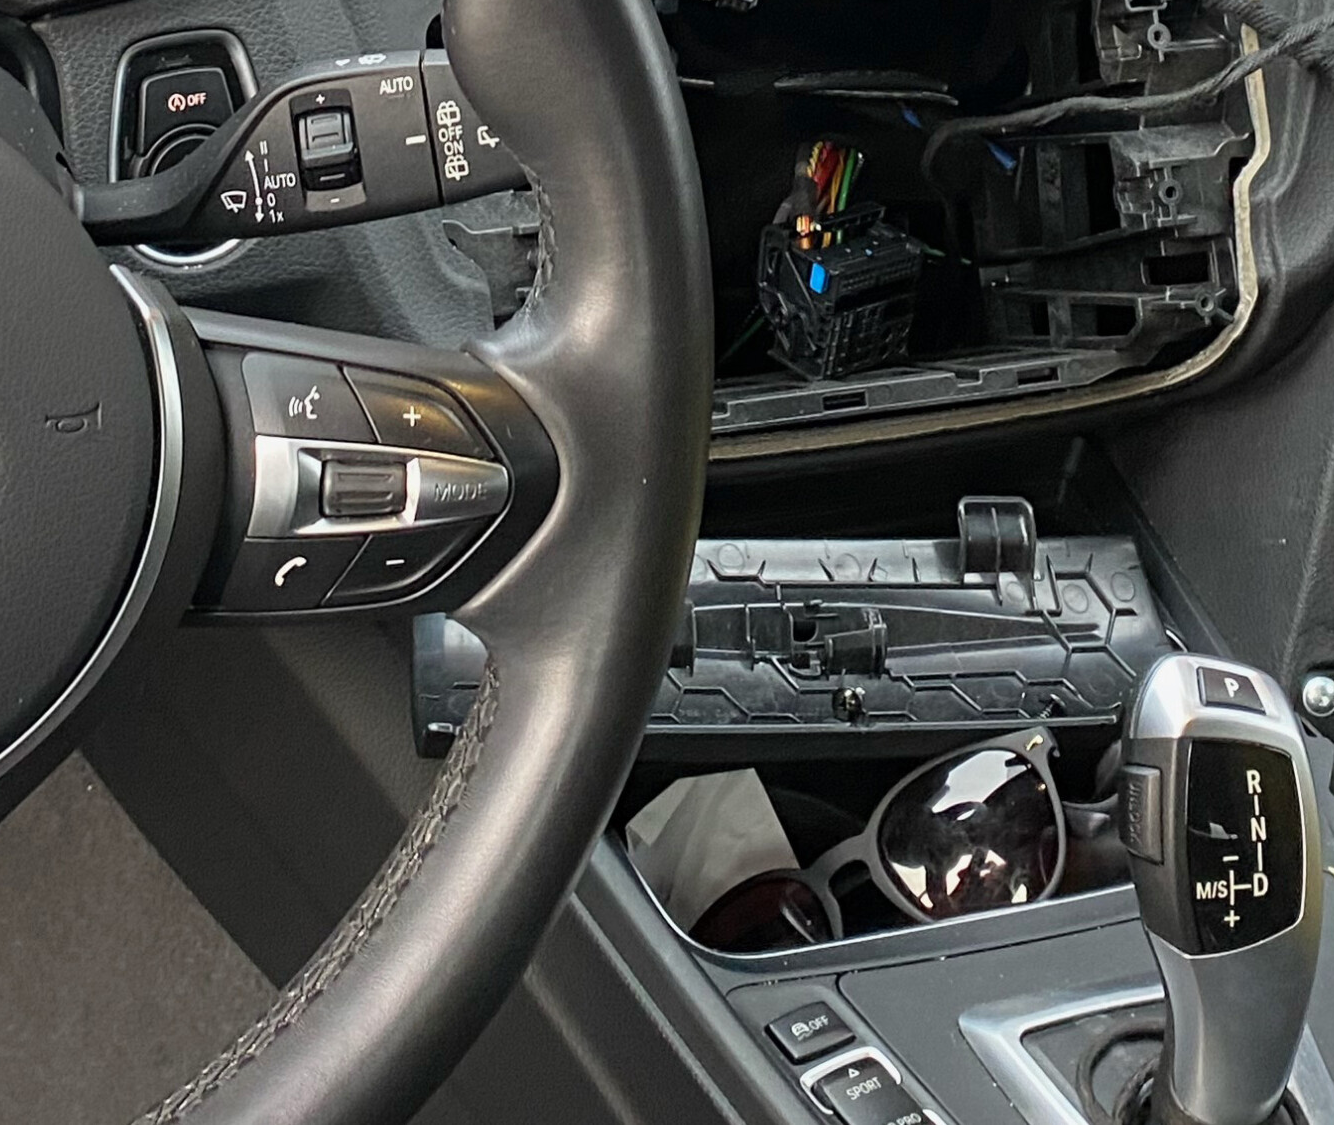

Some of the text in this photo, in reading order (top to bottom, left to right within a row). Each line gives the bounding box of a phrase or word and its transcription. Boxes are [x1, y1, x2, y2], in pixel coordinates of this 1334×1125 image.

[379, 76, 414, 95] AUTO
[187, 92, 207, 107] OFF
[438, 125, 463, 142] OFF
[444, 139, 464, 155] ON
[264, 173, 296, 190] AUTO
[434, 482, 488, 502] MODE
[1223, 677, 1240, 698] P
[1246, 770, 1262, 794] R
[1250, 816, 1267, 842] N
[1196, 873, 1269, 900] M/S D
[809, 1015, 829, 1031] OFF
[845, 1077, 882, 1101] SPORT
